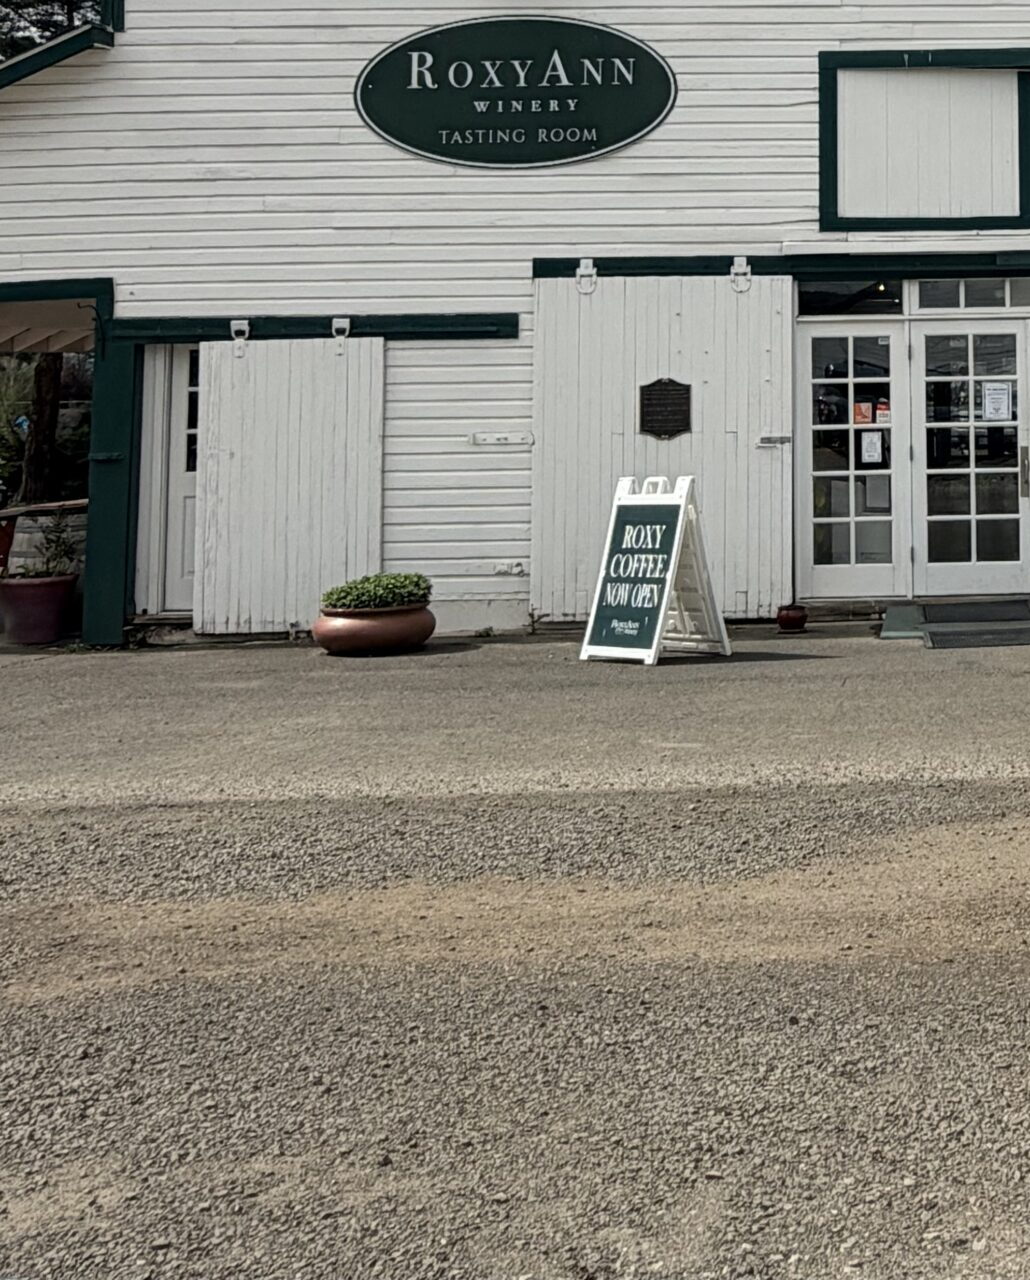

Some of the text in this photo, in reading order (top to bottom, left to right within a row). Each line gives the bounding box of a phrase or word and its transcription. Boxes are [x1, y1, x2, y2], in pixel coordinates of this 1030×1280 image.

[473, 99, 579, 113] WINERY
[439, 128, 597, 144] TASTING ROOM
[622, 524, 667, 549] ROXY
[610, 553, 668, 578] COFFEE
[602, 582, 662, 608] NOW OPEN
